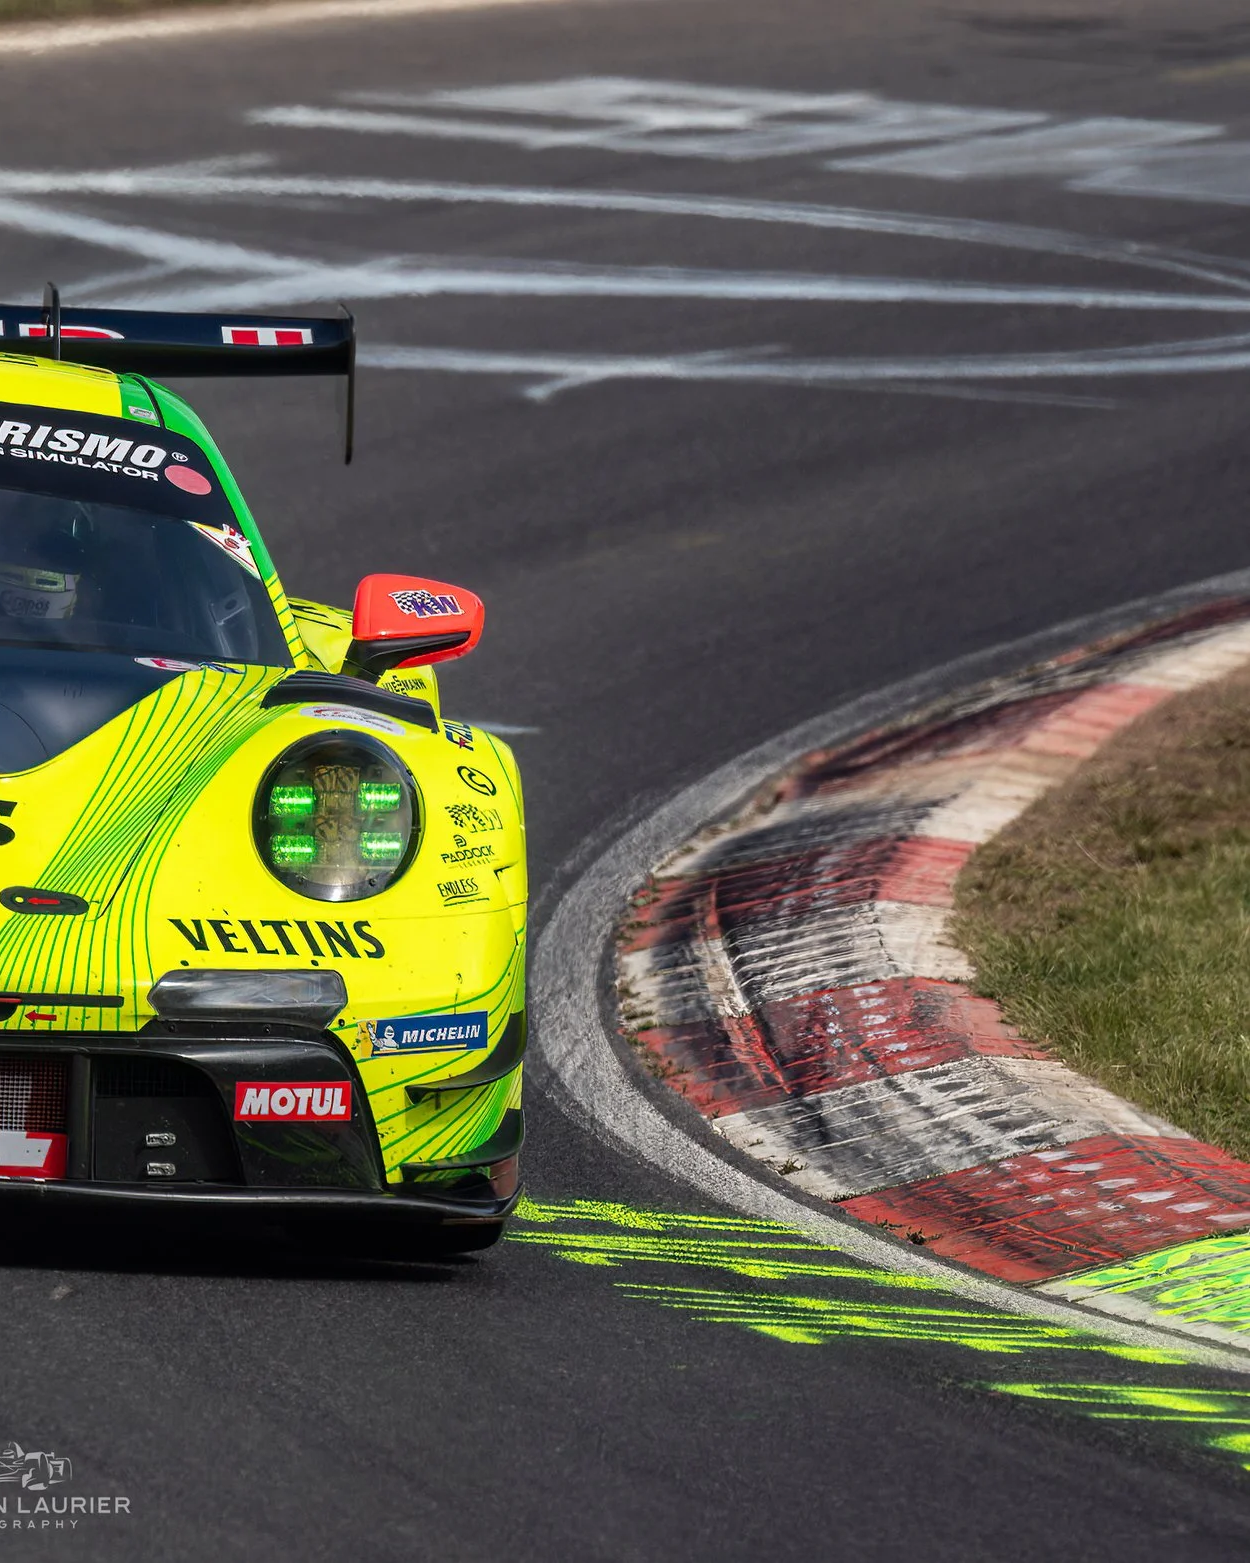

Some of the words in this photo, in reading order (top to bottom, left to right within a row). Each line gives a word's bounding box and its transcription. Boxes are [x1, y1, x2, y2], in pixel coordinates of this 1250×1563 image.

[10, 448, 159, 482] SIMULATOR
[441, 845, 495, 863] PADDOCK
[437, 877, 479, 898] ENDLESS
[168, 918, 386, 959] VELTINS
[401, 1024, 481, 1044] MICHELIN
[239, 1086, 347, 1116] MOTUL
